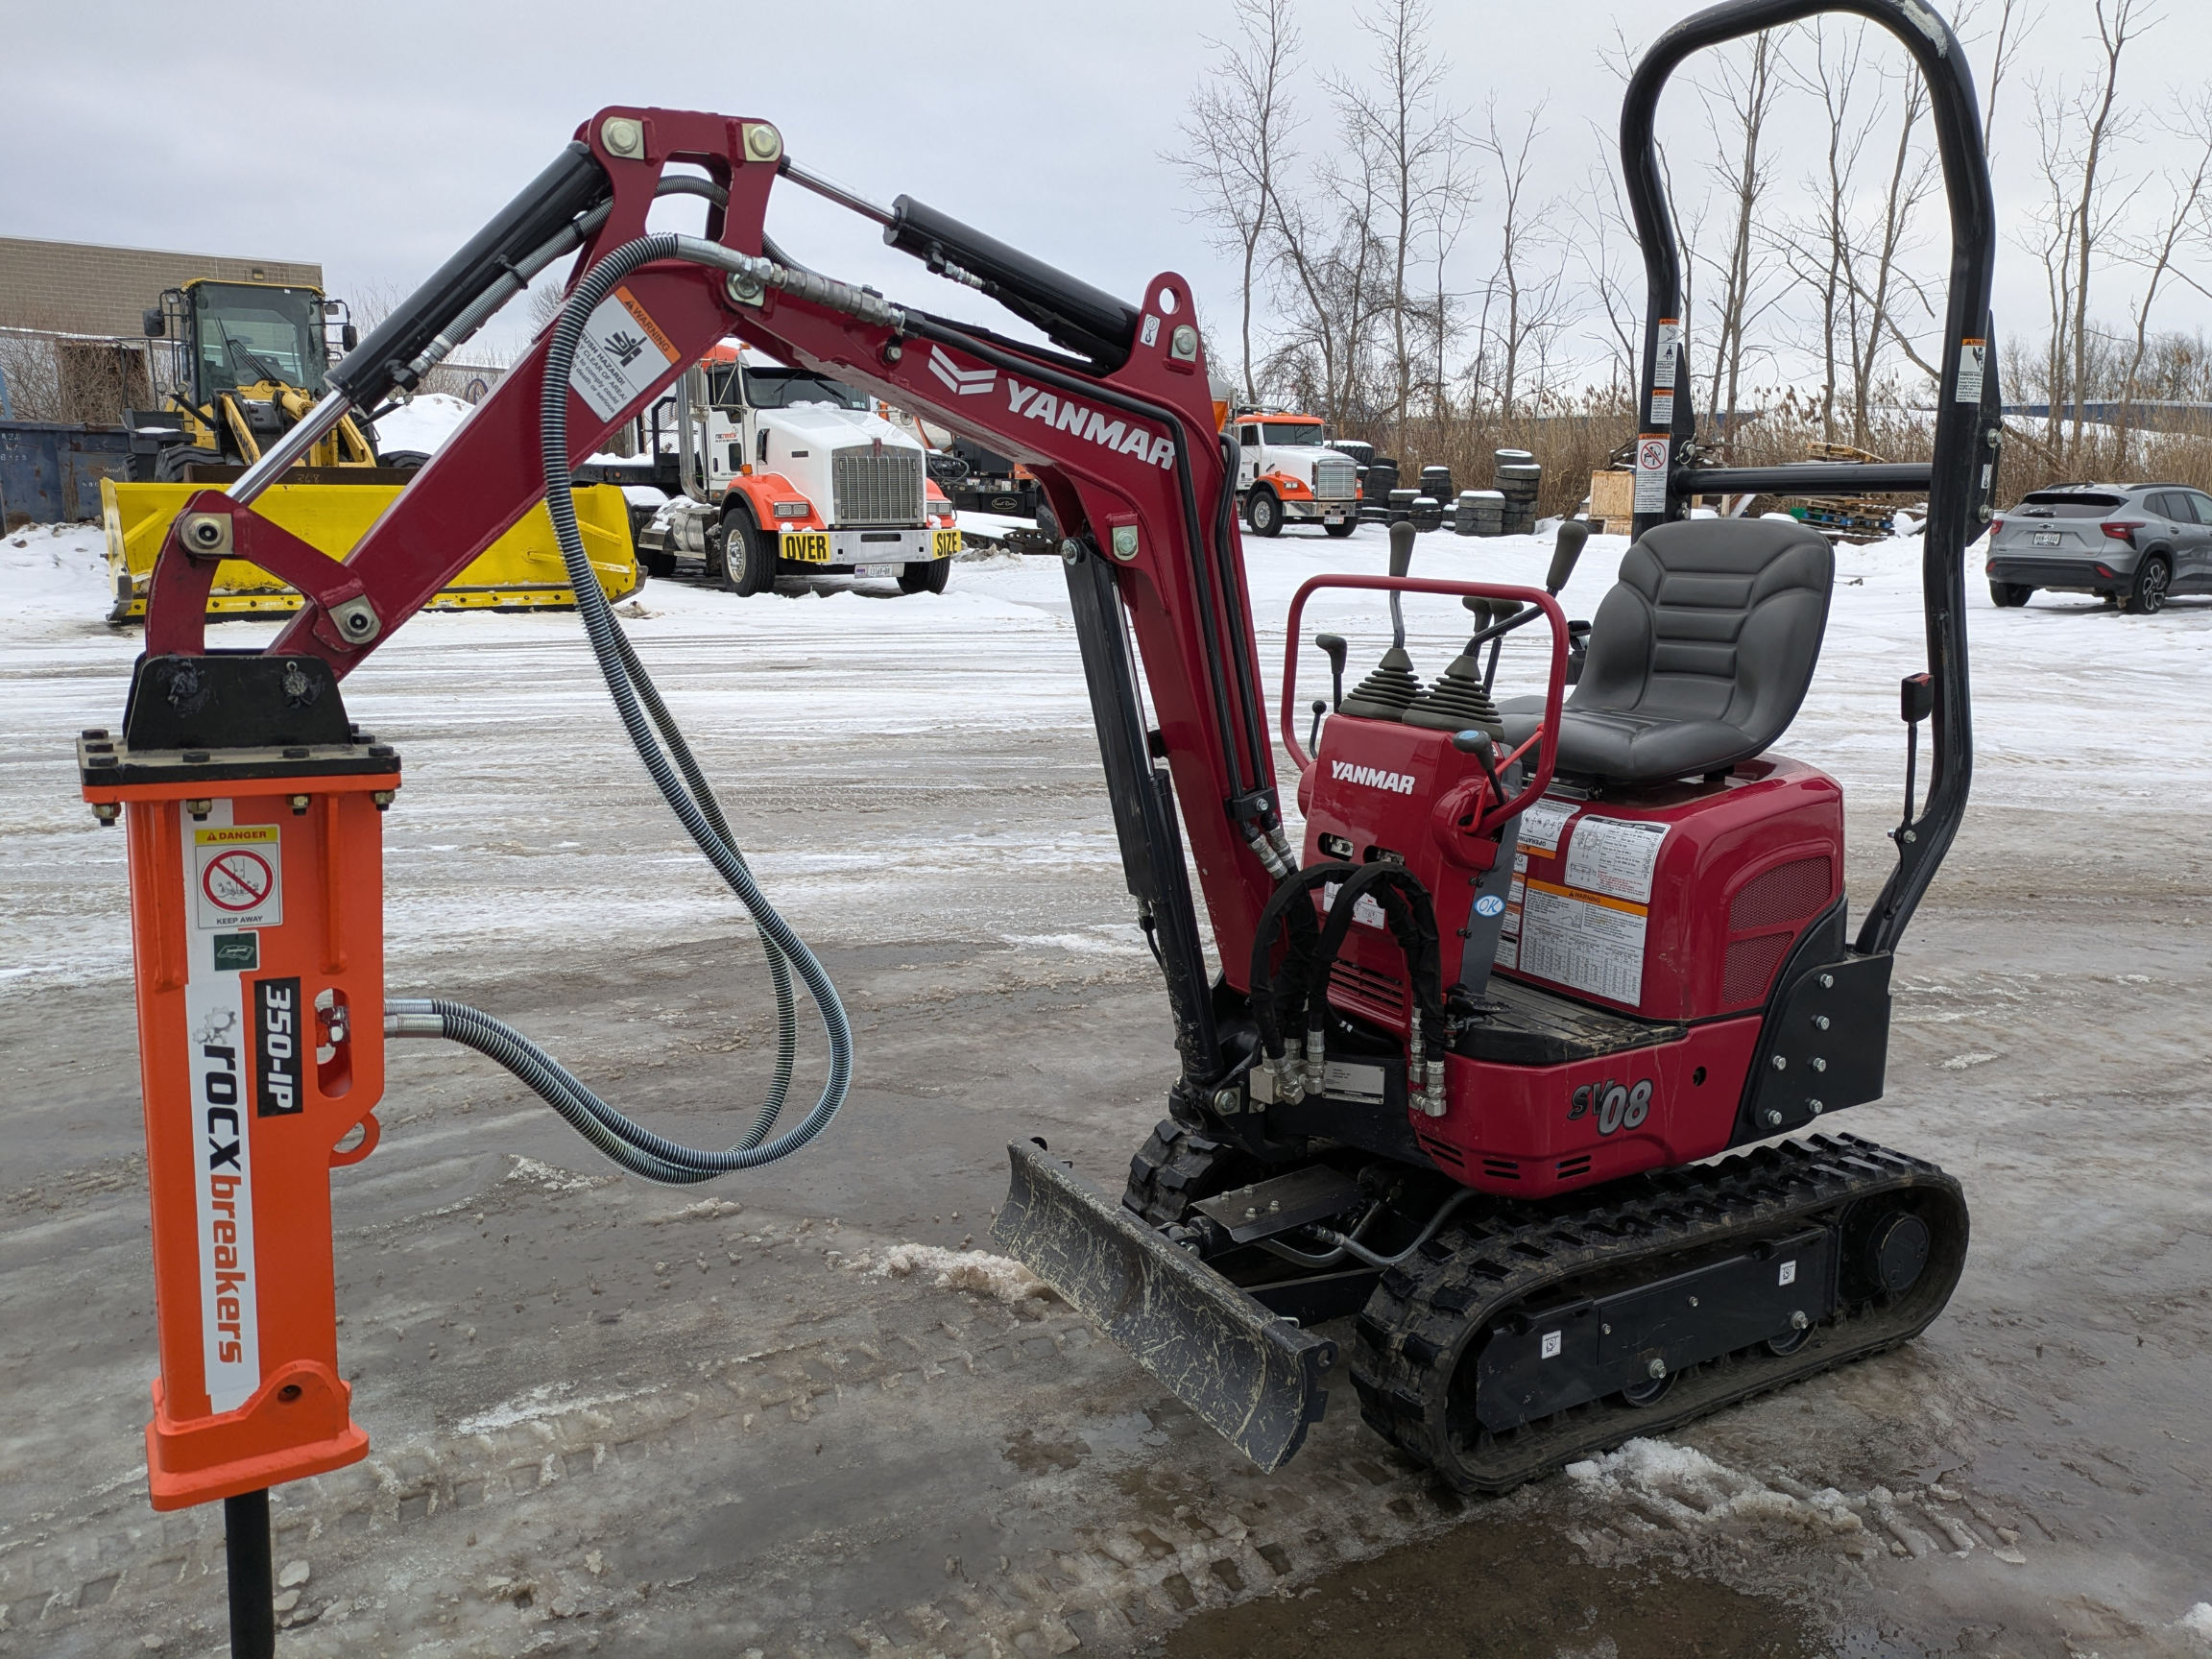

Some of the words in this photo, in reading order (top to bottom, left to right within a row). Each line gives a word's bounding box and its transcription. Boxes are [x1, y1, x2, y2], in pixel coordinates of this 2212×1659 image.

[634, 307, 670, 351] WARNING
[579, 332, 599, 354] RUSH
[597, 352, 625, 386] HAZARD!
[579, 358, 587, 367] to
[586, 366, 604, 388] comply
[603, 387, 619, 404] could
[584, 349, 603, 373] CLEAR
[601, 371, 612, 381] OF
[609, 381, 627, 401] AREA!
[576, 368, 591, 385] death
[596, 392, 615, 414] serious
[1008, 378, 1176, 470] YANMAR
[785, 535, 828, 561] OVER
[936, 532, 957, 556] SIZE
[1332, 760, 1415, 795] YANMAR
[219, 831, 267, 840] DANGER
[1479, 899, 1499, 912] OK
[1575, 892, 1600, 903] WARNING
[266, 985, 293, 1109] 350-IP
